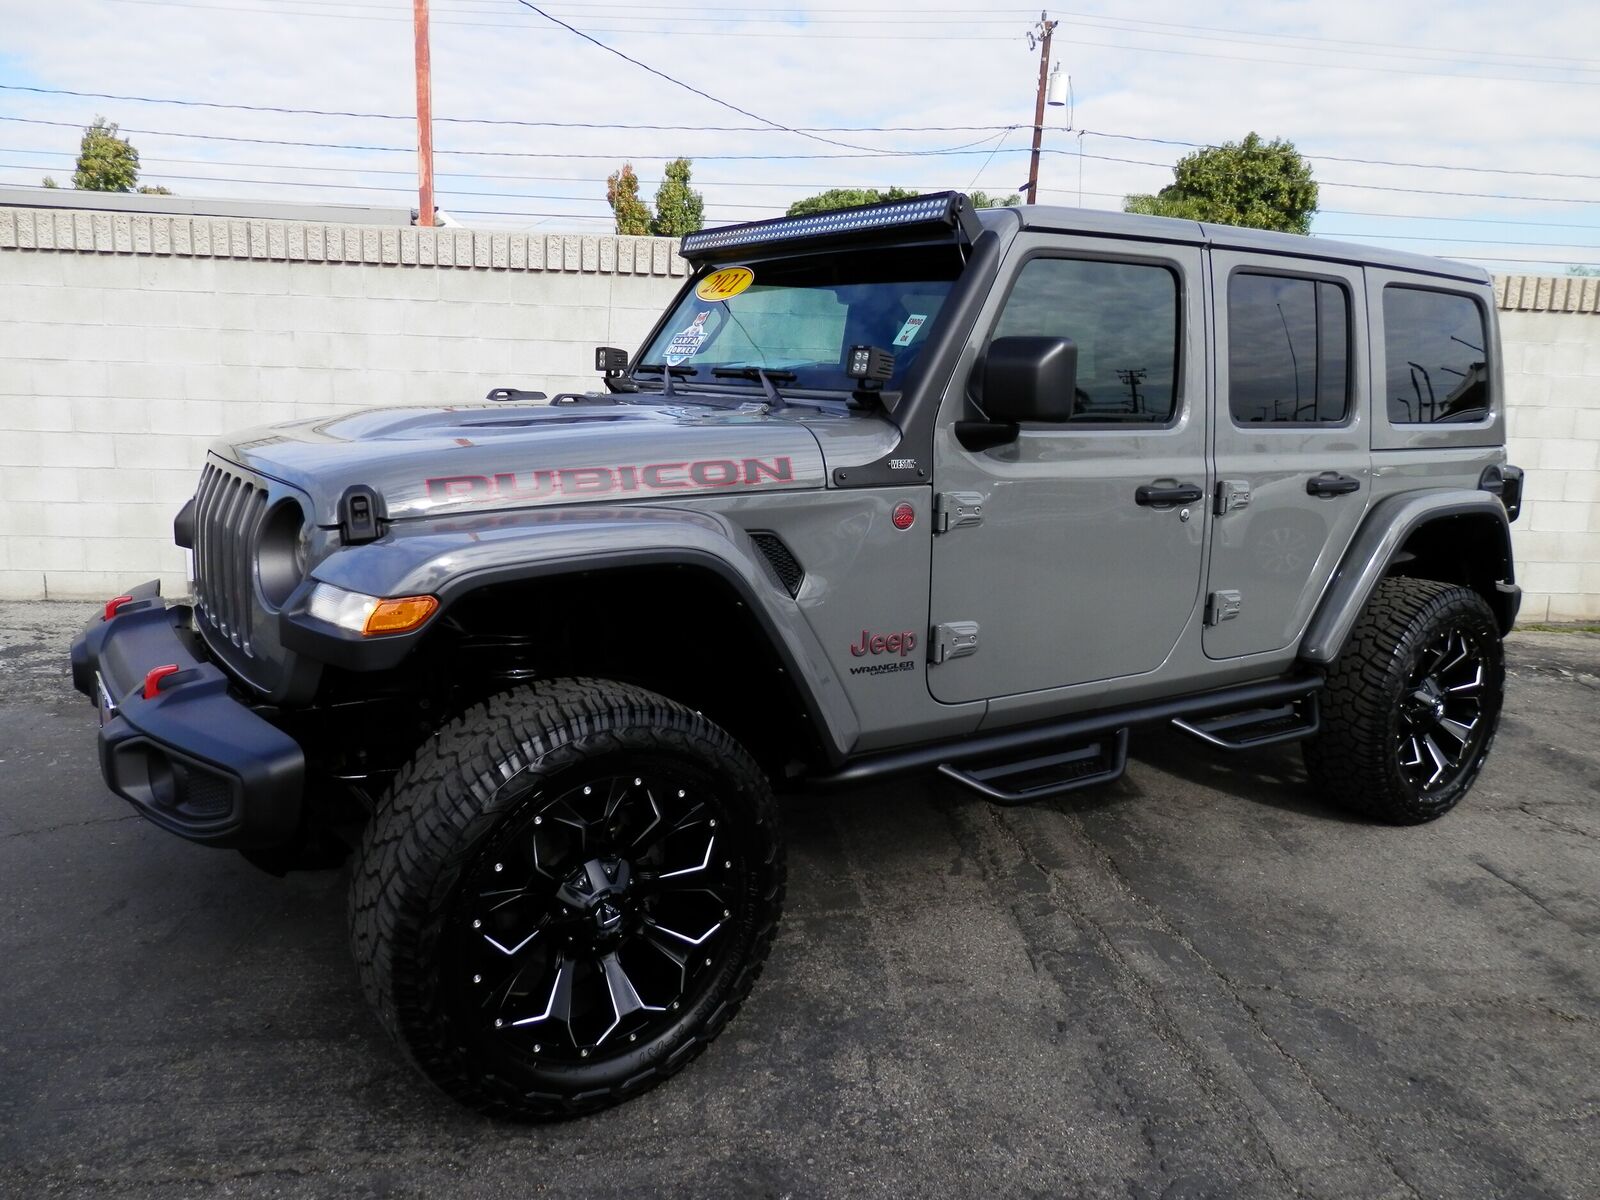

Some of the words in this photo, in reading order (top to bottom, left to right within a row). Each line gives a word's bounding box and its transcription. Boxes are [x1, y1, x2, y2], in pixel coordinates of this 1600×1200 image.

[701, 273, 747, 293] 2021
[424, 456, 794, 503] RUBICON
[850, 630, 917, 657] Jeep
[849, 661, 915, 675] WRANGLER
